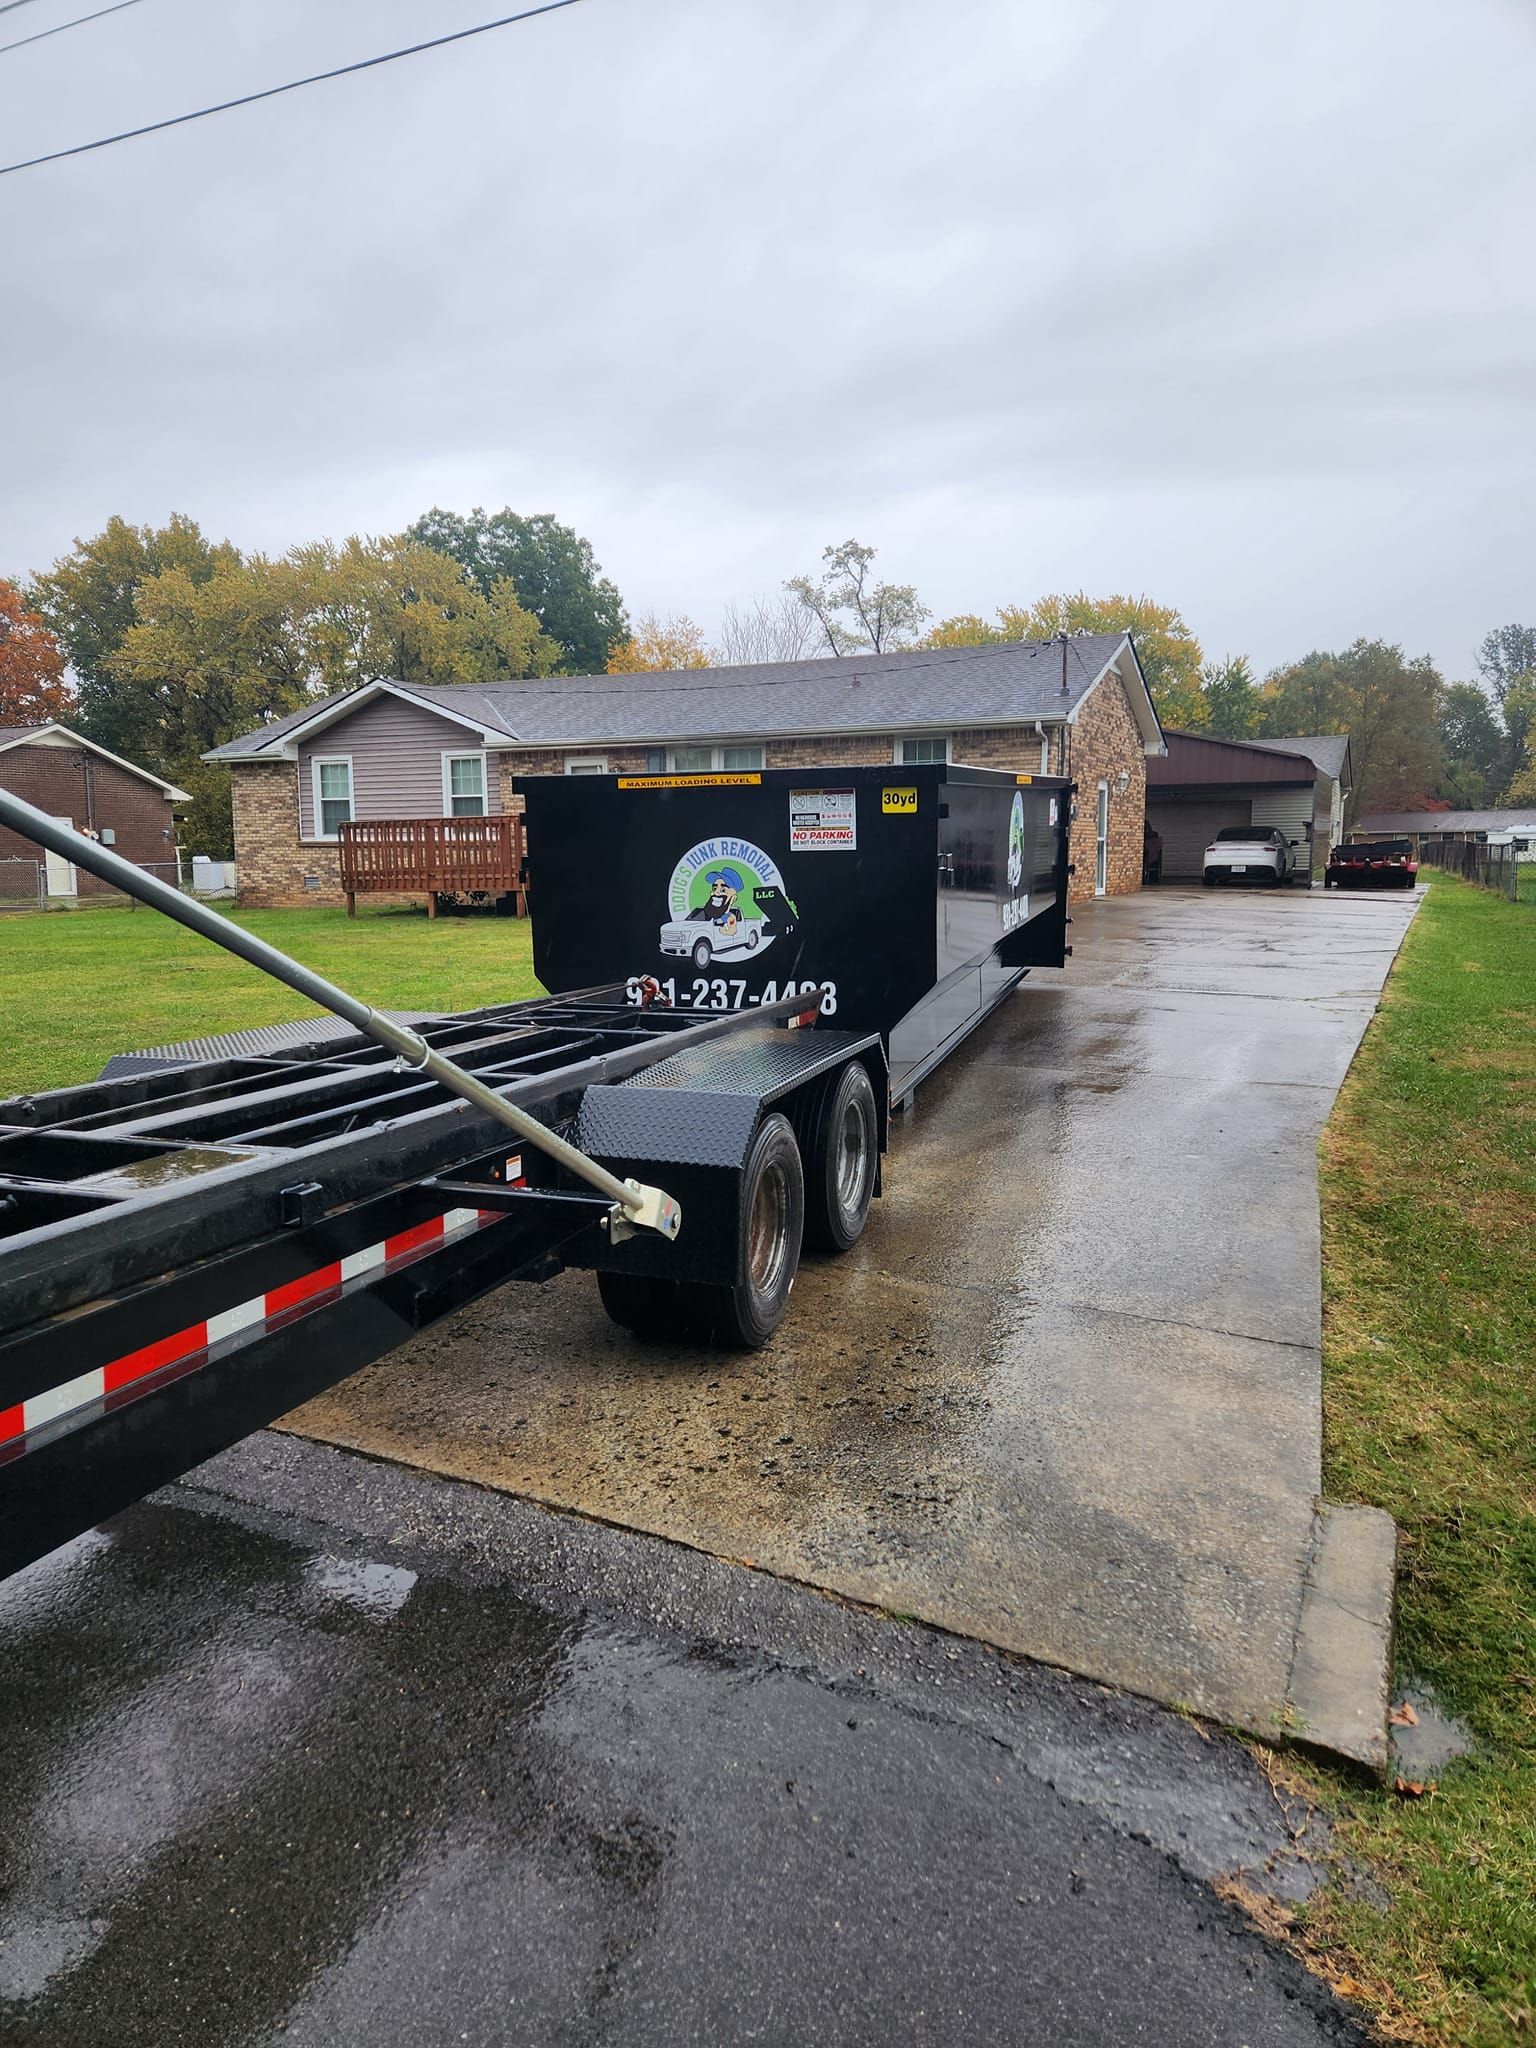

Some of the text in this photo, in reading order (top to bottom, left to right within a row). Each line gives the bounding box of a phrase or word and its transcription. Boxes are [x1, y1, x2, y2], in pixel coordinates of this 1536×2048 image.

[626, 777, 752, 788] MAXIMUM LOADING LEVEL
[883, 792, 916, 807] 30yd
[792, 830, 854, 840] NO PARKING
[671, 840, 775, 913] DOUG'S JUNK REMOVAL
[755, 890, 775, 899] LLC
